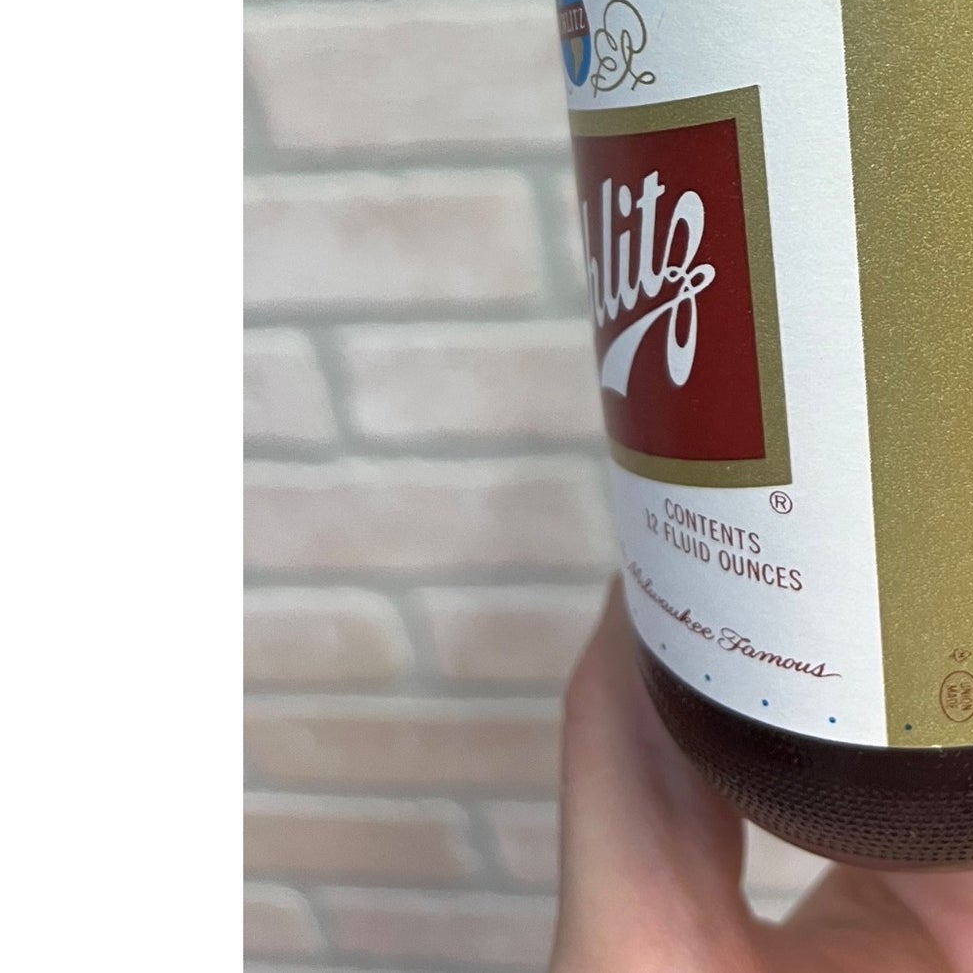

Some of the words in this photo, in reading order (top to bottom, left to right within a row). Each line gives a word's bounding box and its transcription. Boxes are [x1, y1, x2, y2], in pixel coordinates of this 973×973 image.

[664, 497, 762, 555] CONTENTS
[663, 522, 711, 563] FLUID
[718, 549, 803, 591] OUNCES
[717, 627, 842, 678] Famous
